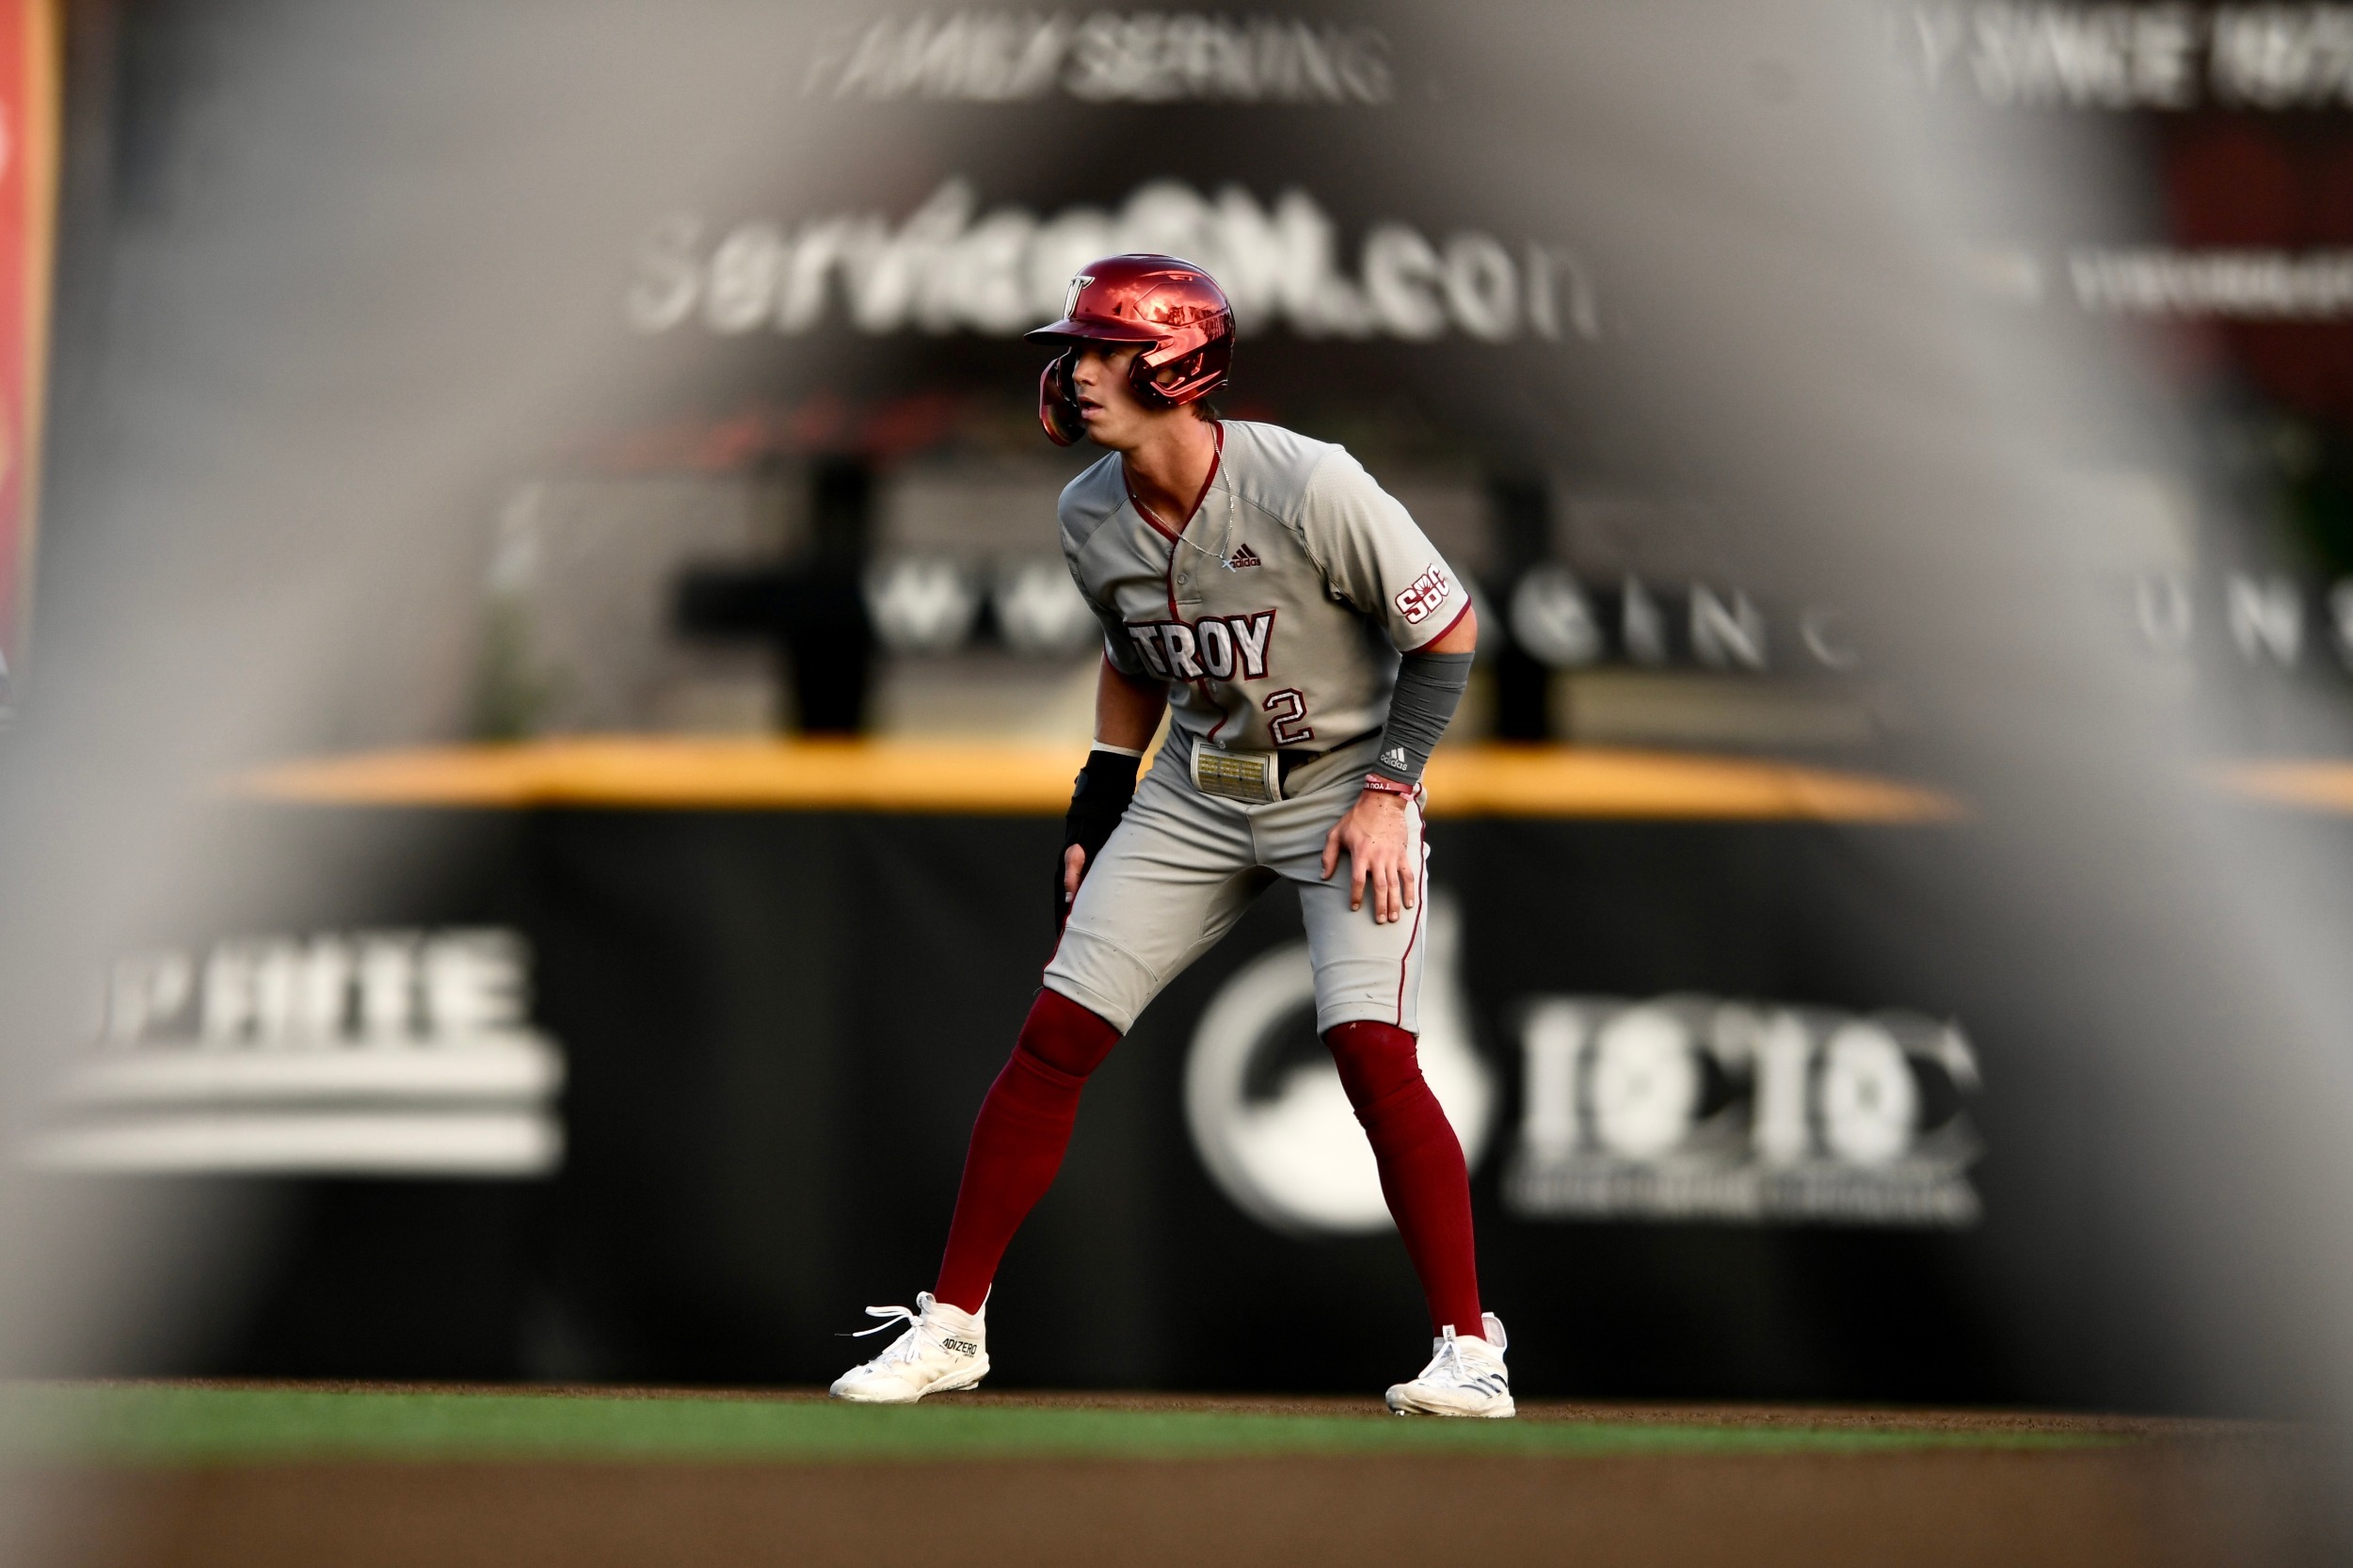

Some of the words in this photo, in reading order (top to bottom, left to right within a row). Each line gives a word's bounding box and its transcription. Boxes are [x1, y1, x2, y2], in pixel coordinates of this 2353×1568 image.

[1229, 556, 1261, 568] adidas
[1395, 563, 1450, 625] SBC
[1125, 609, 1277, 683] TROY
[1262, 688, 1315, 747] 2
[1380, 754, 1408, 771] adidas
[942, 1337, 978, 1355] ADIZERO
